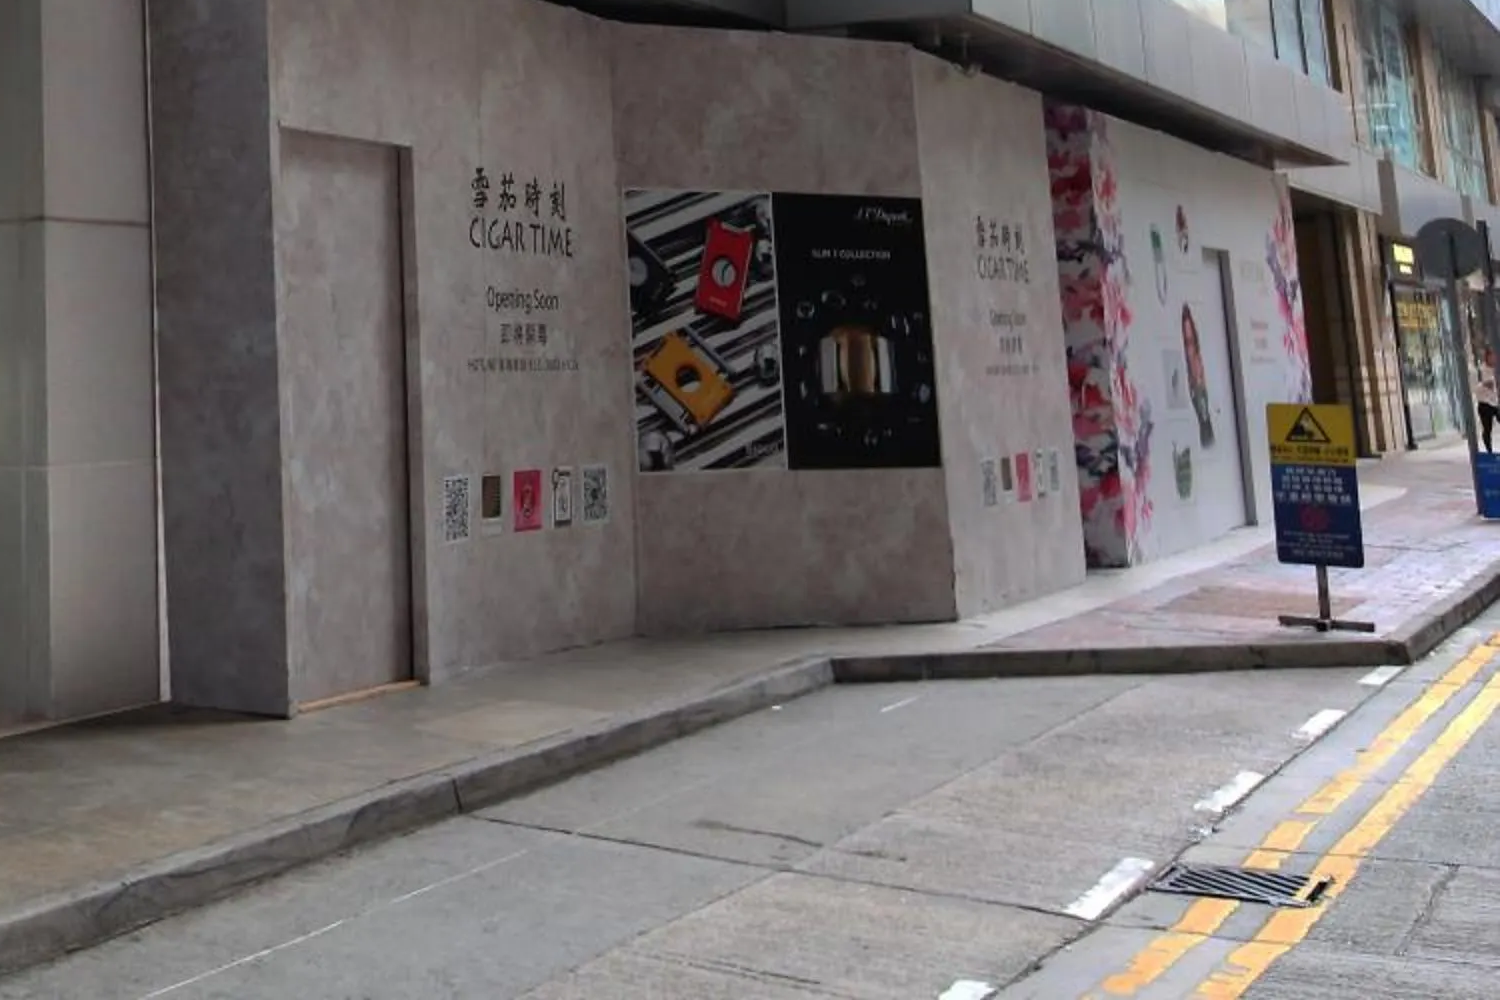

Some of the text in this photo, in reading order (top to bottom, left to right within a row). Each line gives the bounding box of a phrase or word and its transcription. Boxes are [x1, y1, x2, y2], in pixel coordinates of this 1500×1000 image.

[469, 216, 573, 257] CIGAR TIME
[486, 286, 560, 314] Opening Soon
